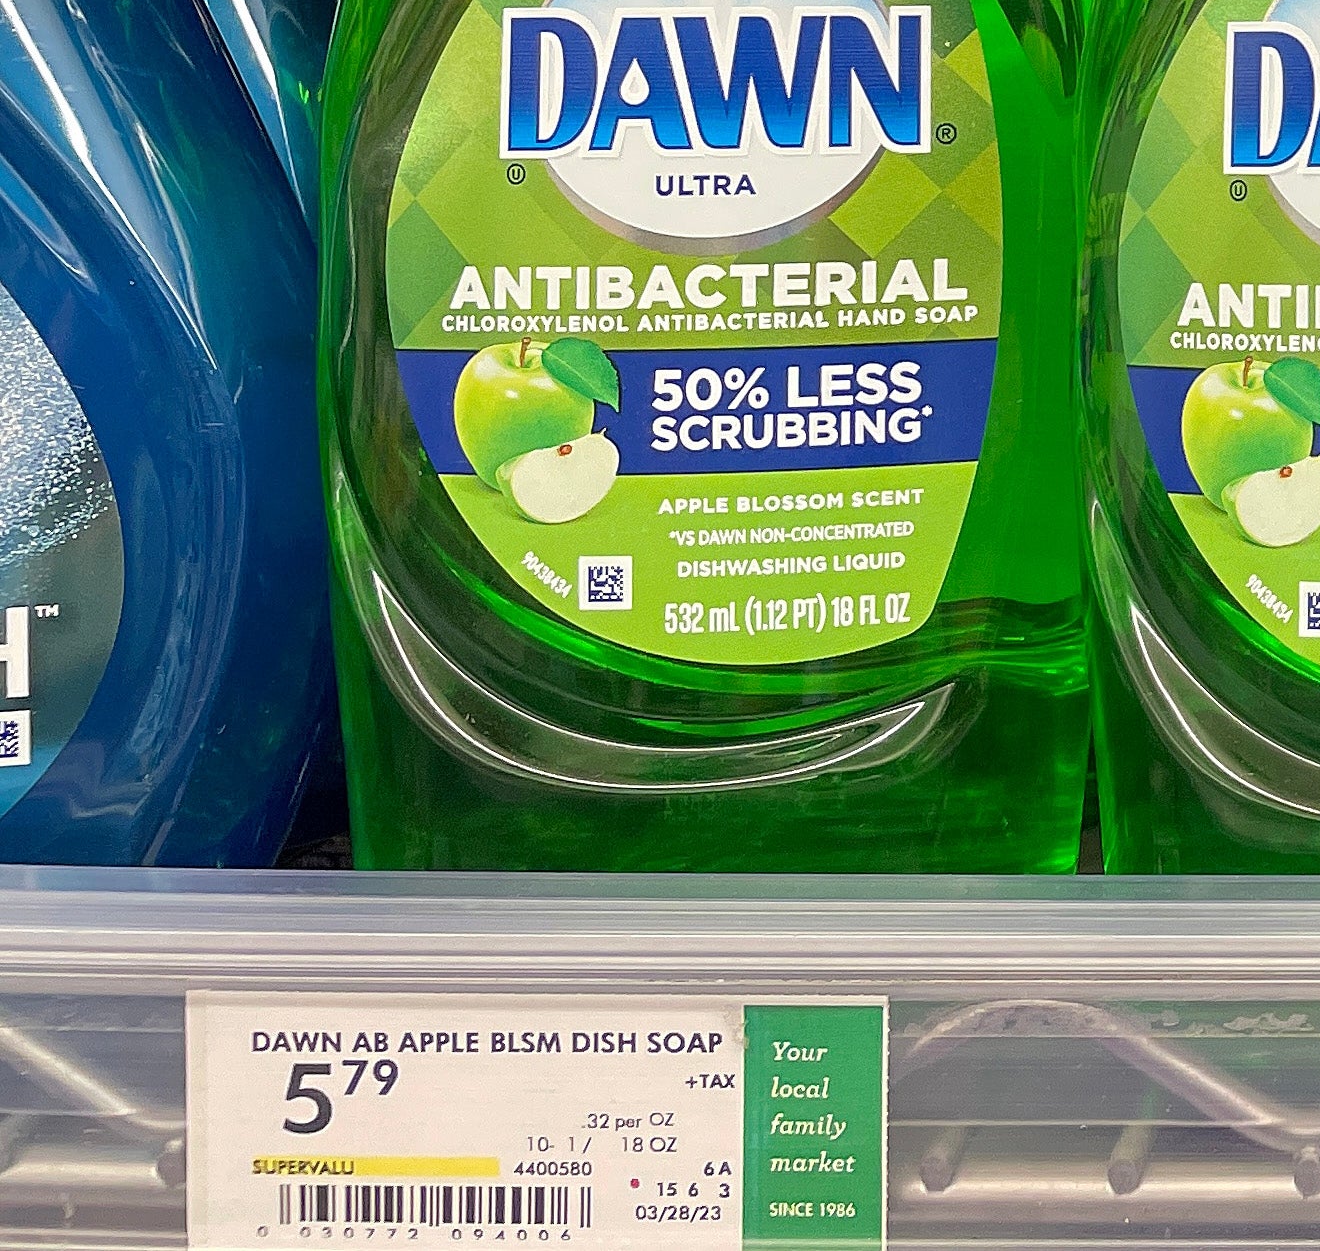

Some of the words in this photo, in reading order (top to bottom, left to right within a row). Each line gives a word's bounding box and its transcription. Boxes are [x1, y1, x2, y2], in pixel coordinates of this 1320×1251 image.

[499, 5, 931, 159] DAWN
[656, 175, 756, 196] ULTRA
[450, 259, 967, 310] ANTIBACTERIAL
[442, 315, 629, 332] CHLOROXYLENOL
[637, 311, 829, 331] ANTIBACTERIAL
[838, 309, 905, 327] HAND
[915, 306, 978, 323] SOAP
[652, 368, 769, 411] 50%
[788, 362, 921, 407] LESS
[658, 497, 728, 514] APPLE
[737, 493, 843, 512] BLOSSOM
[852, 489, 924, 507] SCENT
[699, 529, 746, 546] DAWN
[750, 521, 914, 543] NON-CONCENTRATED
[678, 556, 827, 577] DISHWASHING
[833, 552, 905, 571] LIQUID
[665, 603, 704, 633] 532
[709, 602, 740, 632] mL
[745, 596, 787, 635] (1.12
[793, 593, 826, 632] PT)
[831, 596, 853, 627] 18
[860, 595, 880, 625] FL
[885, 593, 910, 623] OZ
[253, 1032, 341, 1052] DAWN
[352, 1032, 388, 1052] AB
[398, 1032, 478, 1052] APPLE
[491, 1033, 561, 1053] BLSM
[572, 1032, 636, 1053] DISH
[648, 1032, 722, 1053] SOAP
[773, 1042, 828, 1061] Your
[686, 1074, 735, 1088] +TAX
[771, 1077, 829, 1098] local
[283, 1064, 332, 1134] 5
[342, 1059, 398, 1095] 79
[582, 1114, 609, 1129] .32
[615, 1118, 642, 1131] per
[650, 1113, 674, 1126] OZ
[770, 1113, 846, 1140] family
[623, 1137, 643, 1152] 18
[650, 1137, 676, 1152] OZ
[253, 1160, 354, 1175] SUPERVALU
[514, 1162, 591, 1176] 4400580
[771, 1151, 856, 1172] market
[636, 1206, 721, 1222] 03/28/23
[770, 1202, 813, 1217] SINCE
[820, 1203, 855, 1217] 1986
